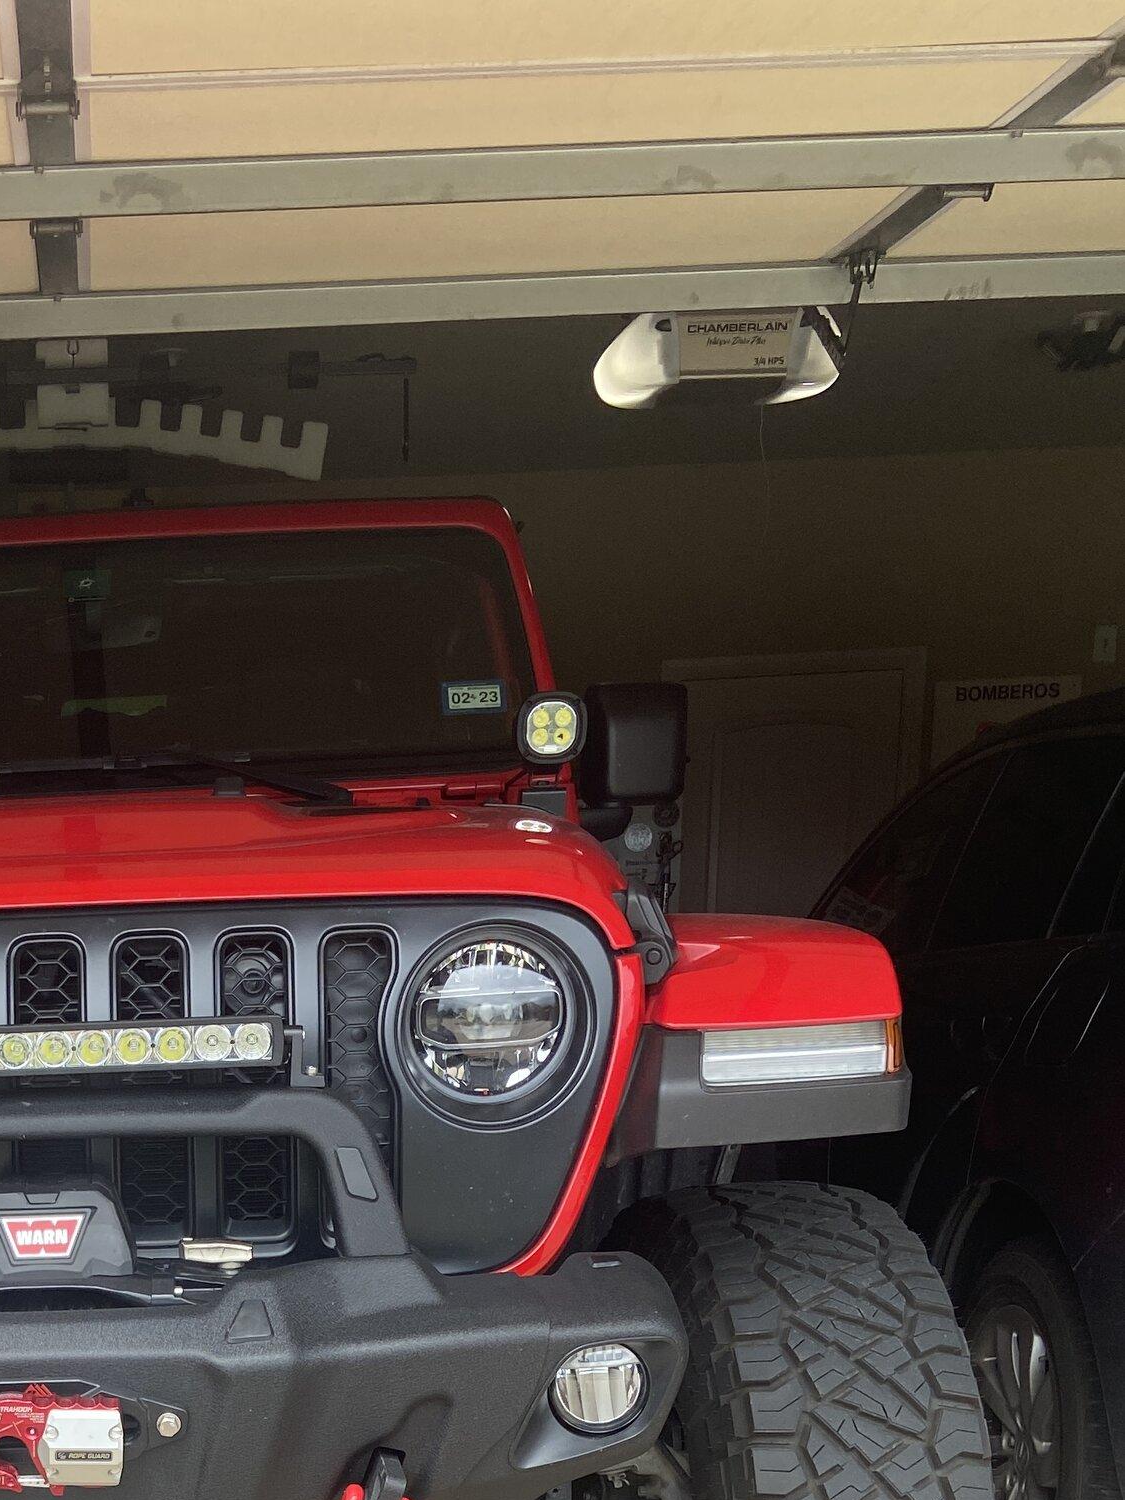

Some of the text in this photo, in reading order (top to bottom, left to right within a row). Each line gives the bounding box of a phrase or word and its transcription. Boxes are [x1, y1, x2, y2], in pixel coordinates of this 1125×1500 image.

[687, 321, 788, 333] CHAMBERLAIN
[451, 690, 498, 705] 02 23
[955, 682, 1061, 702] BOMBEROS
[16, 1228, 68, 1246] WARN
